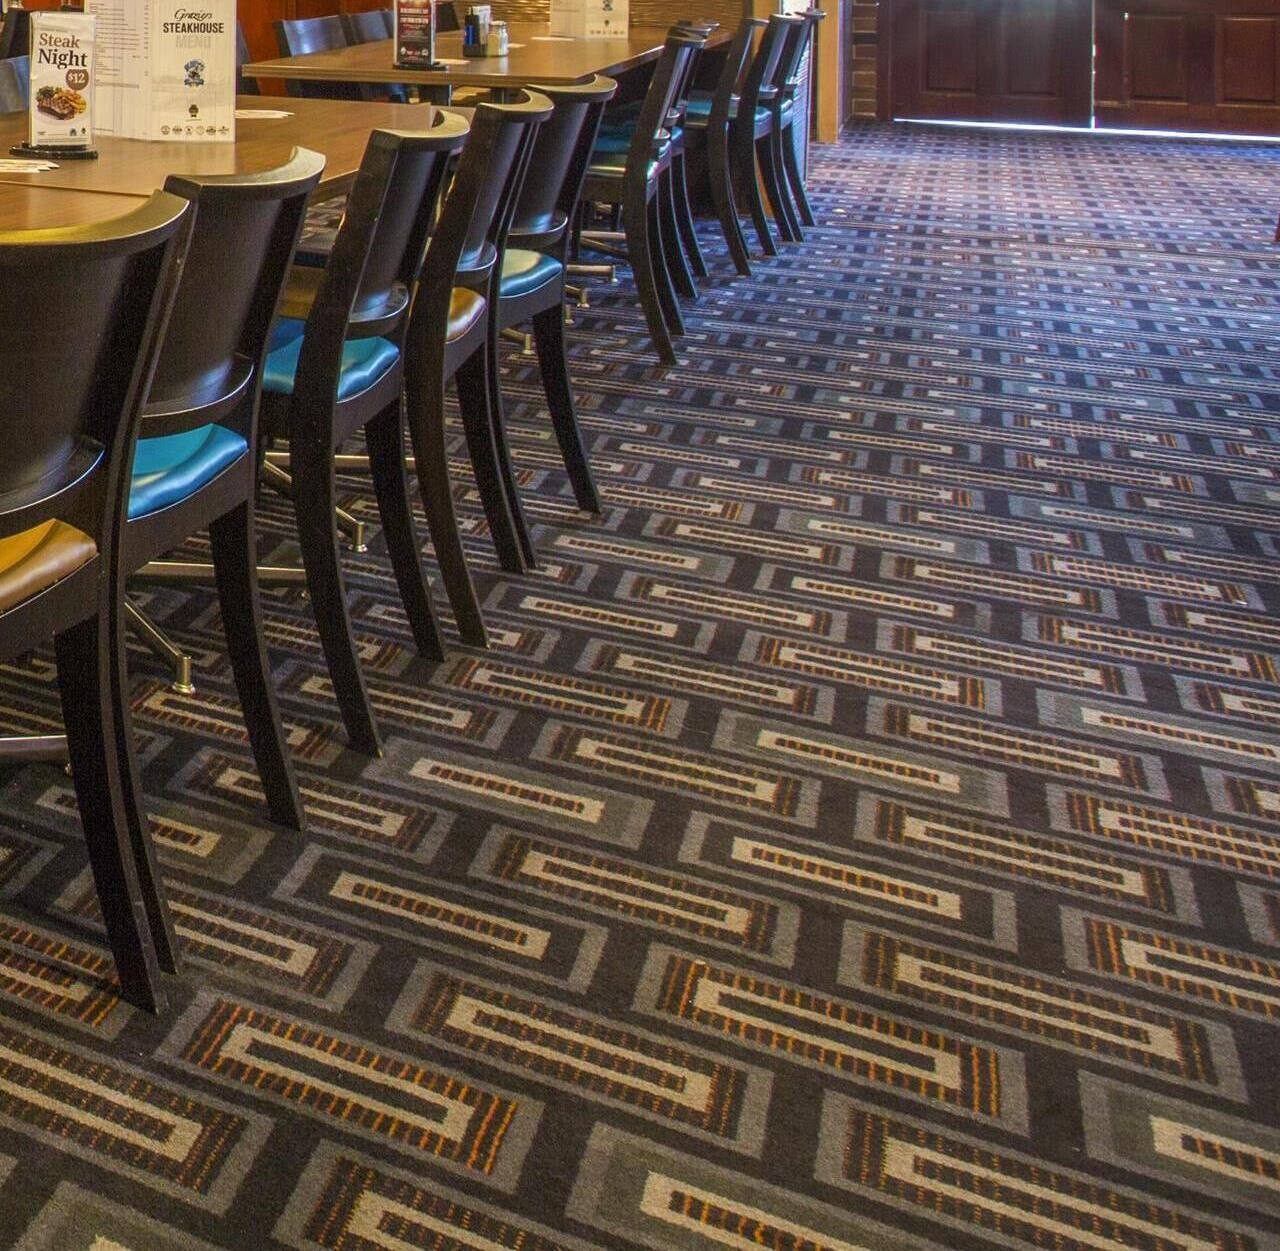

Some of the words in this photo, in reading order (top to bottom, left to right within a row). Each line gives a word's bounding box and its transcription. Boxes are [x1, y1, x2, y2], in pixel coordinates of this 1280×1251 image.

[162, 22, 225, 34] STEAKHOUSE
[39, 32, 81, 49] Steak
[175, 35, 212, 49] MENU
[37, 48, 88, 70] Night
[68, 72, 86, 84] $12
